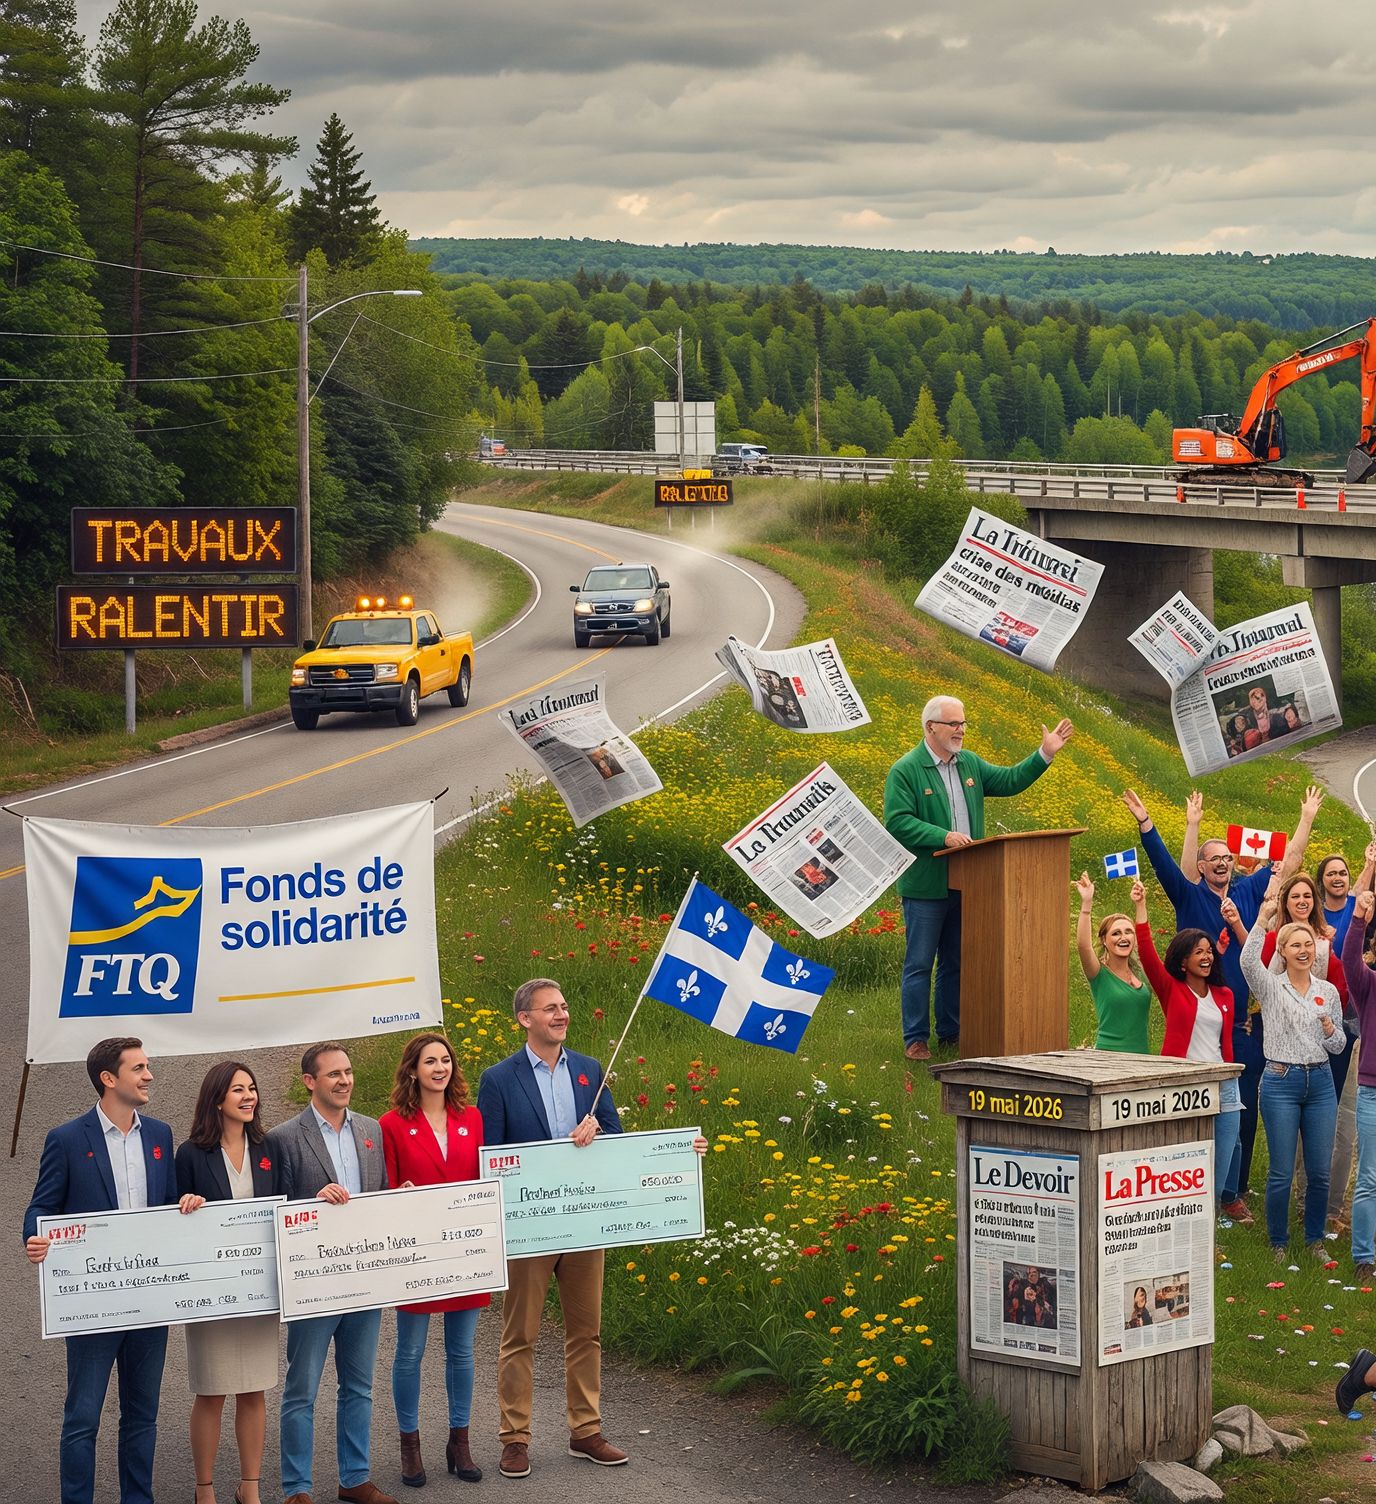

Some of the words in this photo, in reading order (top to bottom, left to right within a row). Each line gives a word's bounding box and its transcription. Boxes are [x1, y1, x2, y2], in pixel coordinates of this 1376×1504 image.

[88, 519, 282, 562] TRAVAUX
[971, 516, 998, 545] La
[69, 595, 285, 639] RALENTIR
[220, 862, 346, 904] Fonds
[357, 856, 404, 892] de
[220, 898, 408, 951] solidarité
[73, 953, 180, 1001] FTQ
[968, 1090, 984, 1111] 19
[990, 1093, 1020, 1116] mai
[1024, 1095, 1063, 1120] 2026
[1112, 1099, 1131, 1120] 19
[1136, 1094, 1167, 1116] mai
[1172, 1088, 1211, 1113] 2026
[974, 1157, 1001, 1187] Le
[1004, 1160, 1075, 1194] Devoir
[1105, 1170, 1132, 1201] La
[1135, 1164, 1205, 1197] Presse
